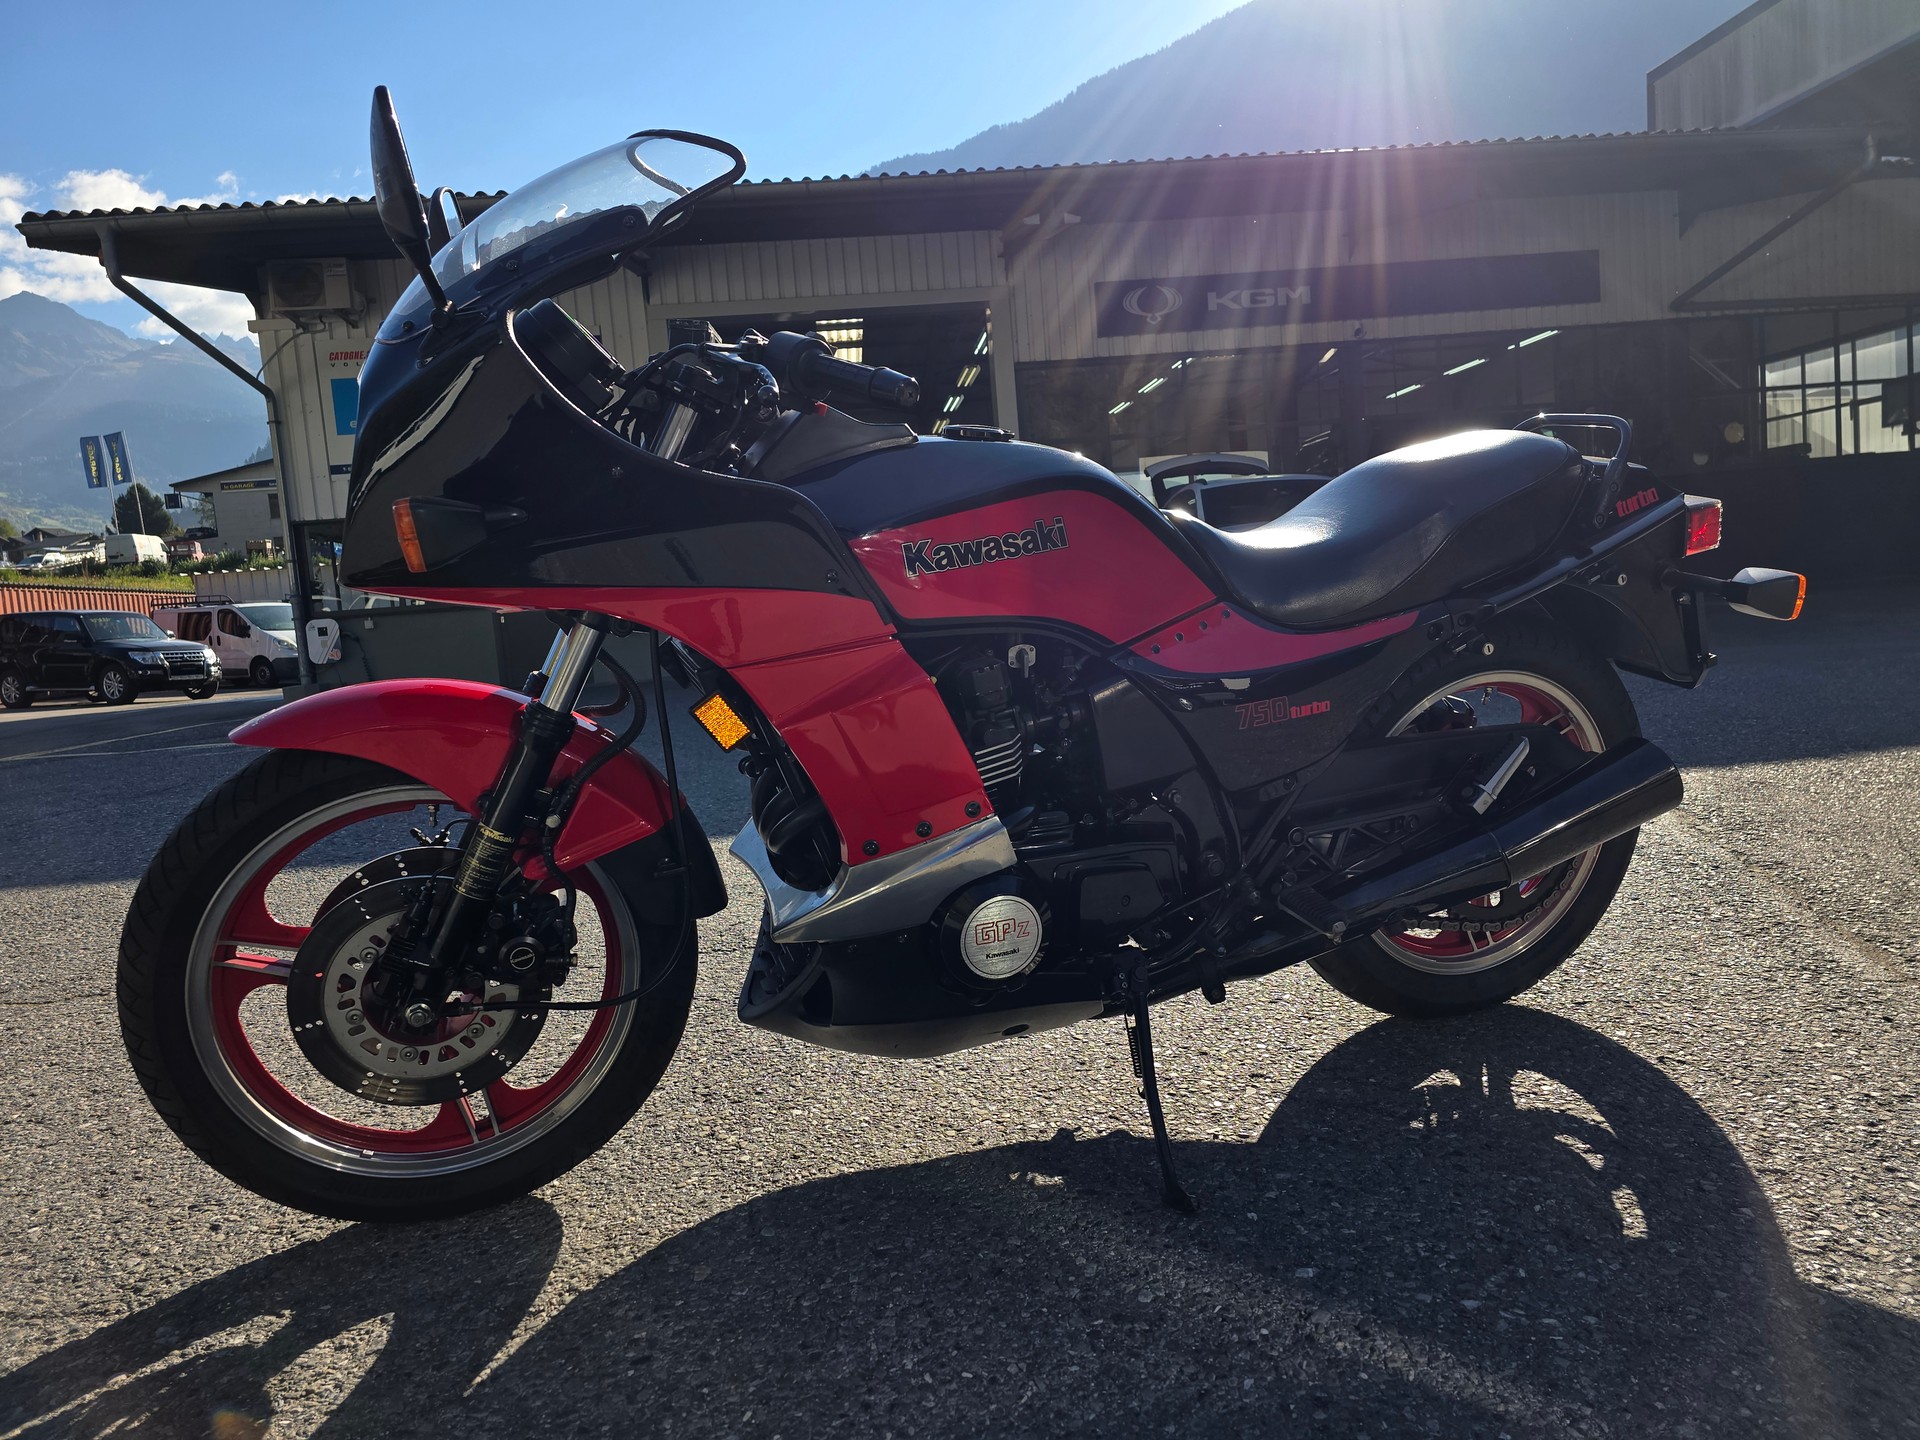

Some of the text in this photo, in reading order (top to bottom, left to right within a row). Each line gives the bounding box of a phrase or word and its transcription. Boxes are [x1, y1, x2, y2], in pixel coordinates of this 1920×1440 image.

[1207, 285, 1311, 312] KGM
[1615, 487, 1660, 518] turbo
[901, 516, 1069, 578] Kawasaki
[1235, 696, 1331, 730] 750 turbo
[985, 947, 1020, 960] Kawasaki
